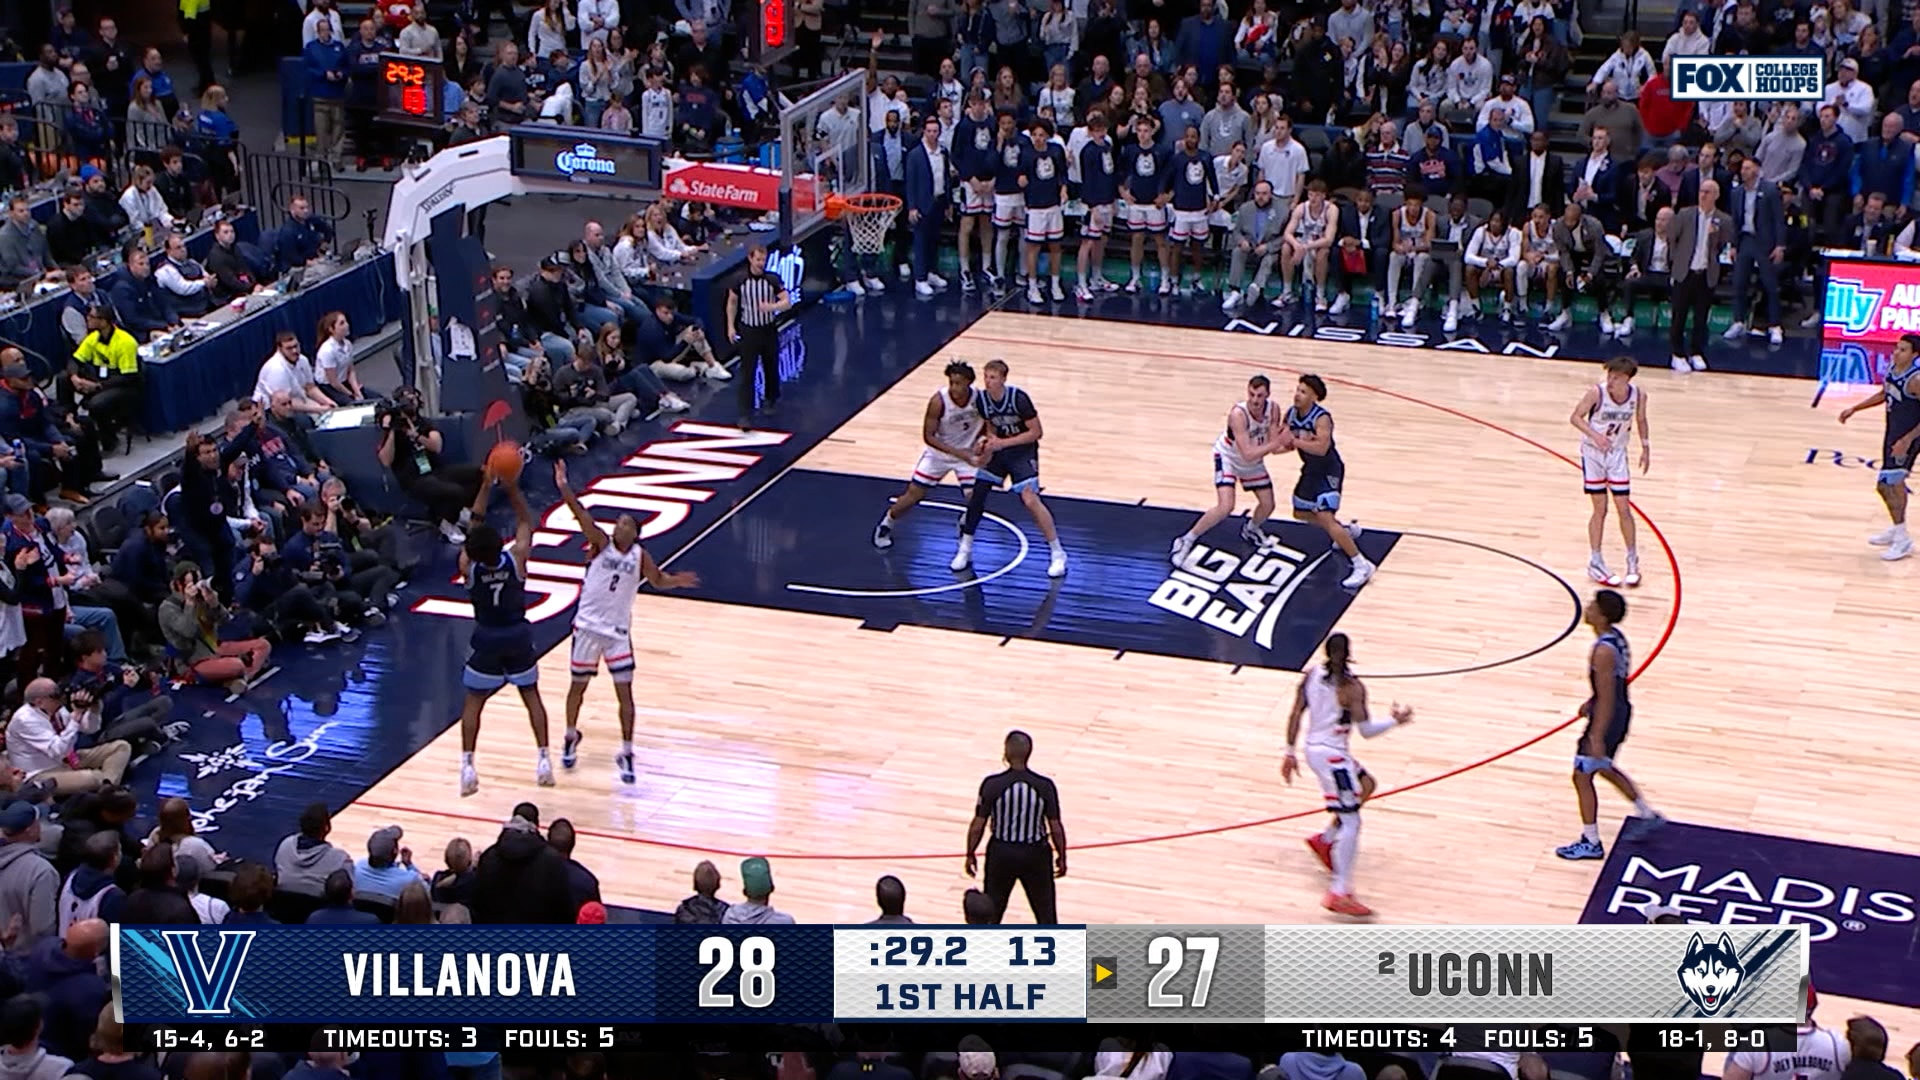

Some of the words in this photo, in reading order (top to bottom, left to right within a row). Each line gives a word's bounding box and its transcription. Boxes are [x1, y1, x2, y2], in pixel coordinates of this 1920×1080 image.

[386, 62, 425, 85] 29.2
[557, 151, 616, 174] Corona
[1224, 319, 1559, 358] NISSAN
[490, 582, 504, 606] 7
[609, 574, 620, 592] 2
[1148, 544, 1241, 619] BIG
[1198, 535, 1307, 637] EAST
[1621, 857, 1915, 922] MADIS
